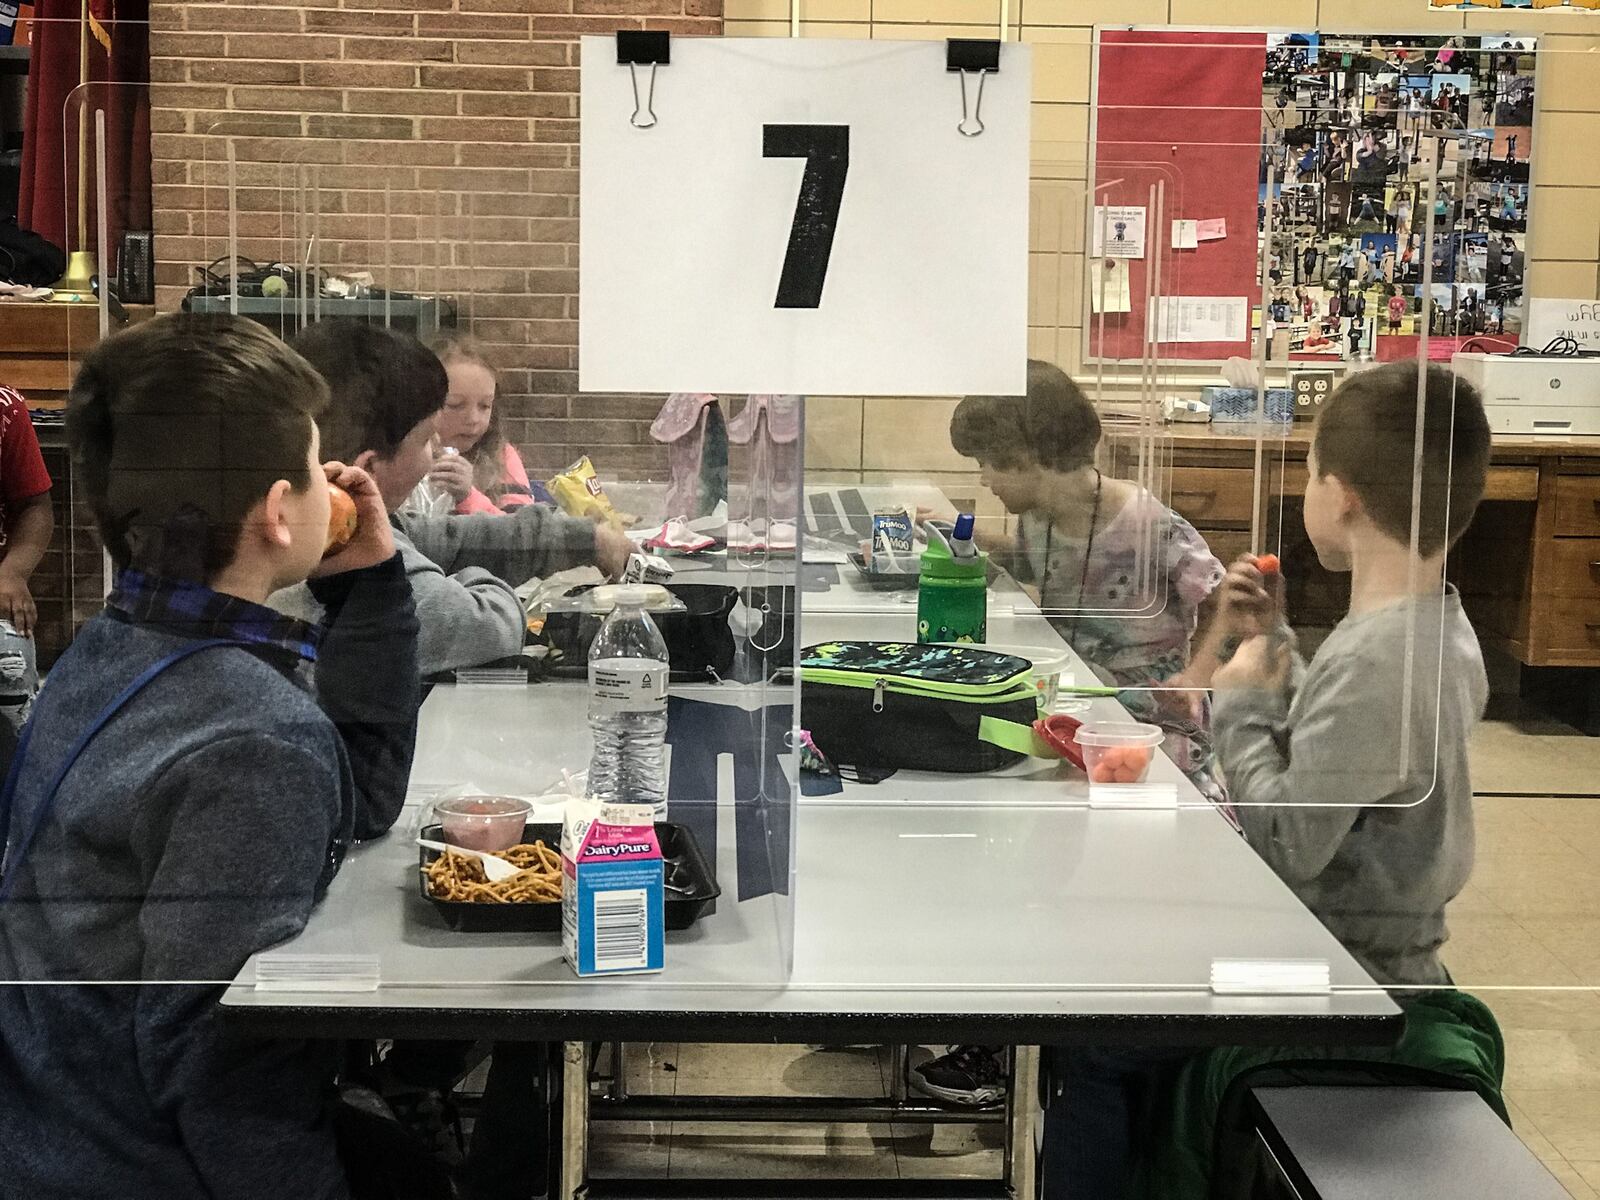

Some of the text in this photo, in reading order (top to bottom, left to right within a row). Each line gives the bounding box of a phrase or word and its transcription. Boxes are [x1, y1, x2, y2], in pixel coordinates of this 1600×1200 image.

[762, 124, 850, 309] 7
[879, 520, 907, 531] TruMoo
[874, 535, 910, 551] TrMoo
[584, 843, 650, 856] DairyPure
